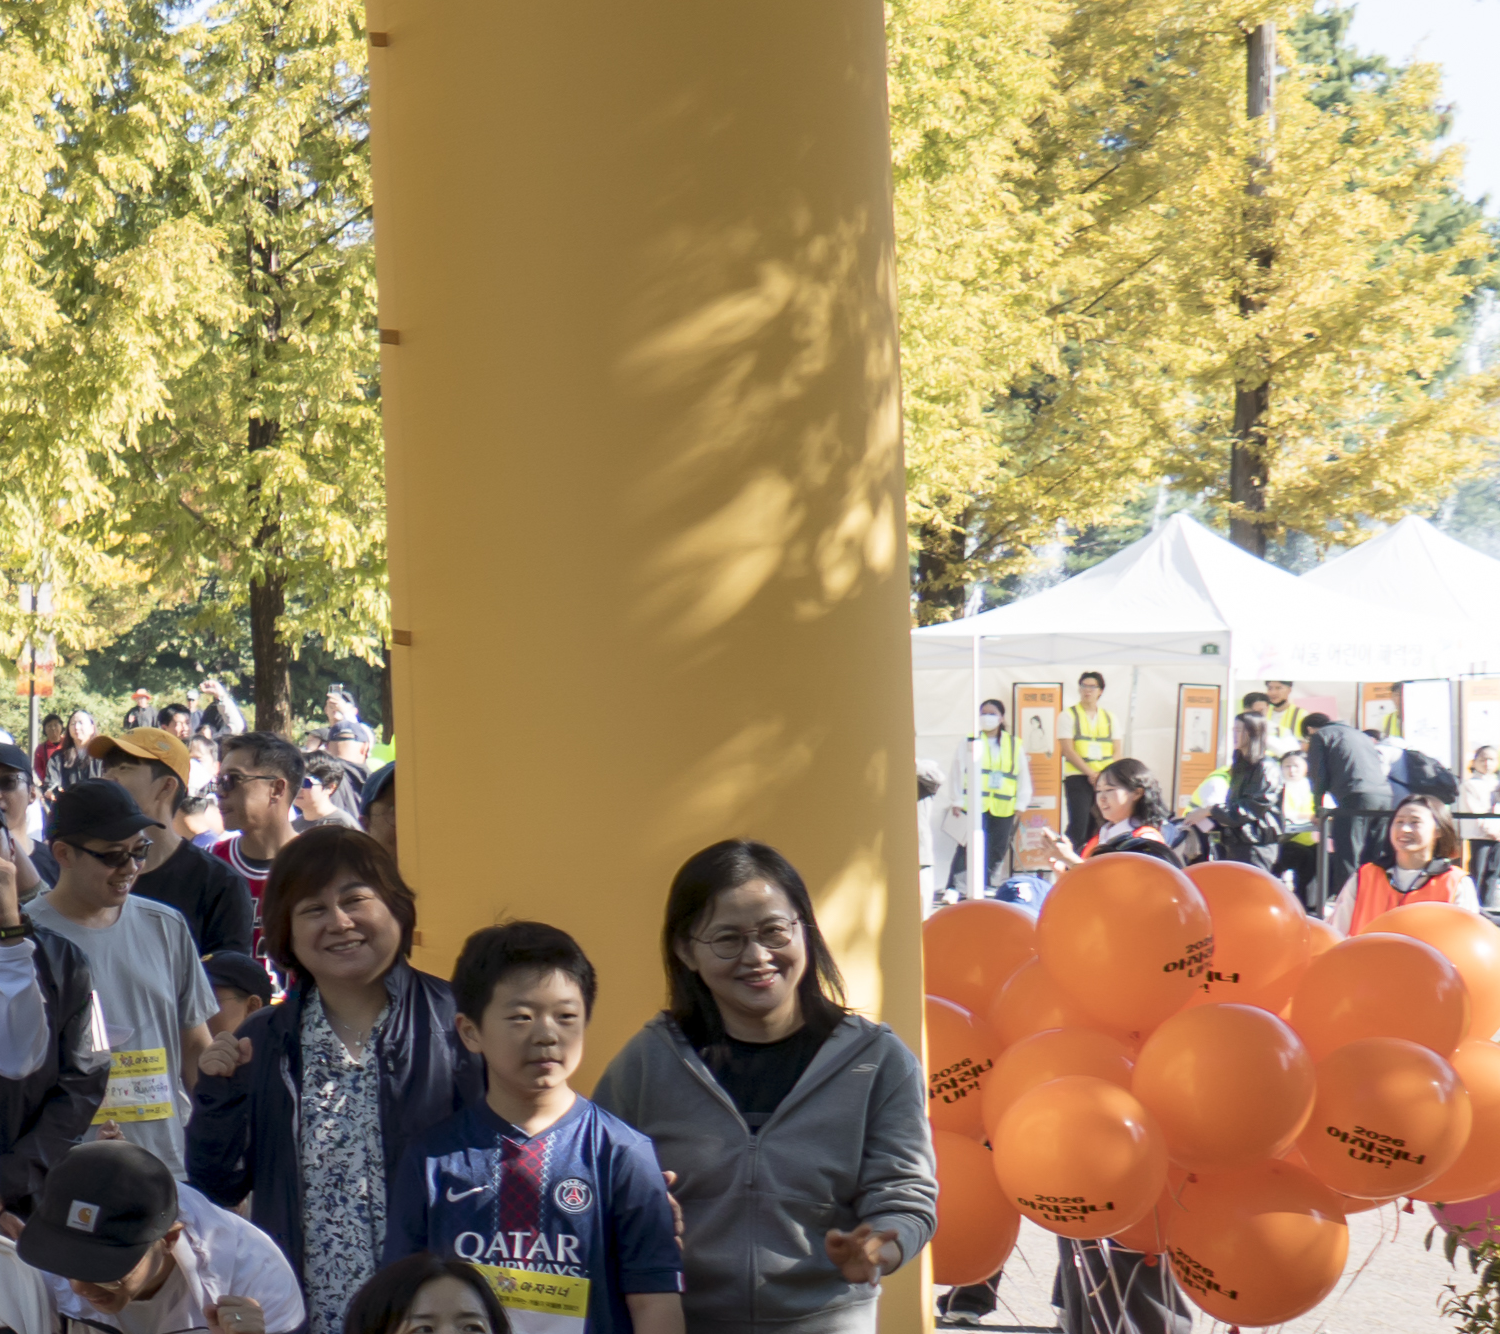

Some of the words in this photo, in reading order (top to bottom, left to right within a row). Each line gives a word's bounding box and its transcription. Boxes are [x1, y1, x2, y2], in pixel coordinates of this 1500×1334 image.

[930, 1057, 972, 1082] 2026
[942, 1081, 981, 1104] UP!
[1326, 1125, 1426, 1166] 아자러너
[1353, 1125, 1406, 1147] 2026
[1348, 1148, 1393, 1170] UP!
[1017, 1197, 1116, 1215] 아자러너
[1034, 1194, 1086, 1204] 2026
[454, 1230, 581, 1264] QATAR
[519, 1281, 570, 1298] 아자러너
